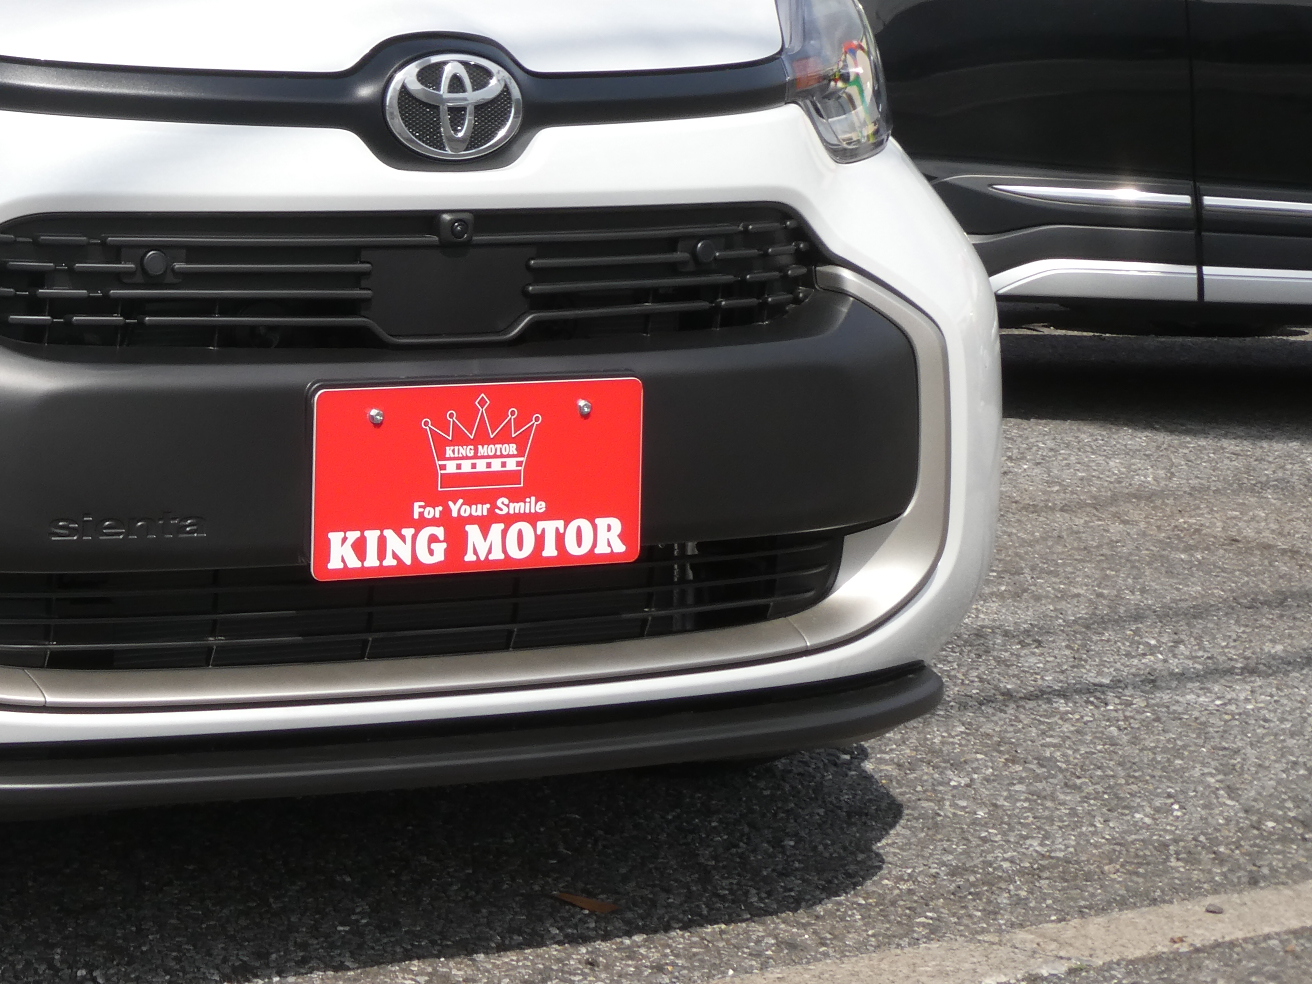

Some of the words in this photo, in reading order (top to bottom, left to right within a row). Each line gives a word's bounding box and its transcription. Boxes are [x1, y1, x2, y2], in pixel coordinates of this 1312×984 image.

[445, 445, 475, 458] KING
[477, 443, 518, 456] MOTOR
[413, 501, 443, 519] For
[448, 498, 491, 517] Your
[494, 496, 547, 515] Smile
[48, 512, 207, 541] sienta
[327, 527, 448, 570] KING
[463, 517, 627, 562] MOTOR
